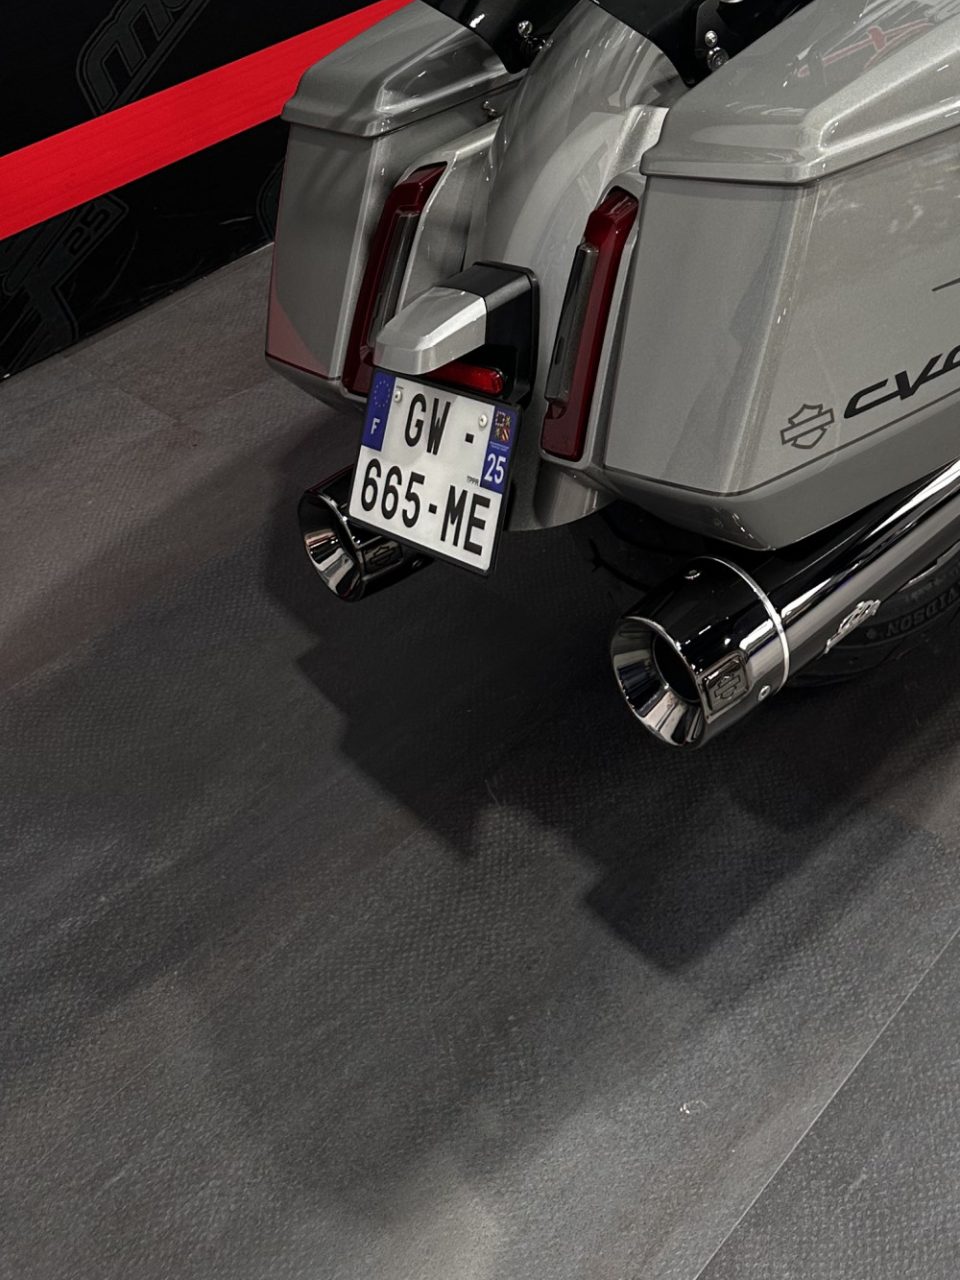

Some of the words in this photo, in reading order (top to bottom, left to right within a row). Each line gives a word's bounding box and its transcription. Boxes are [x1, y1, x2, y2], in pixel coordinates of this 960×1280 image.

[370, 418, 381, 435] F
[484, 453, 507, 484] 25
[360, 458, 491, 556] 665-ME
